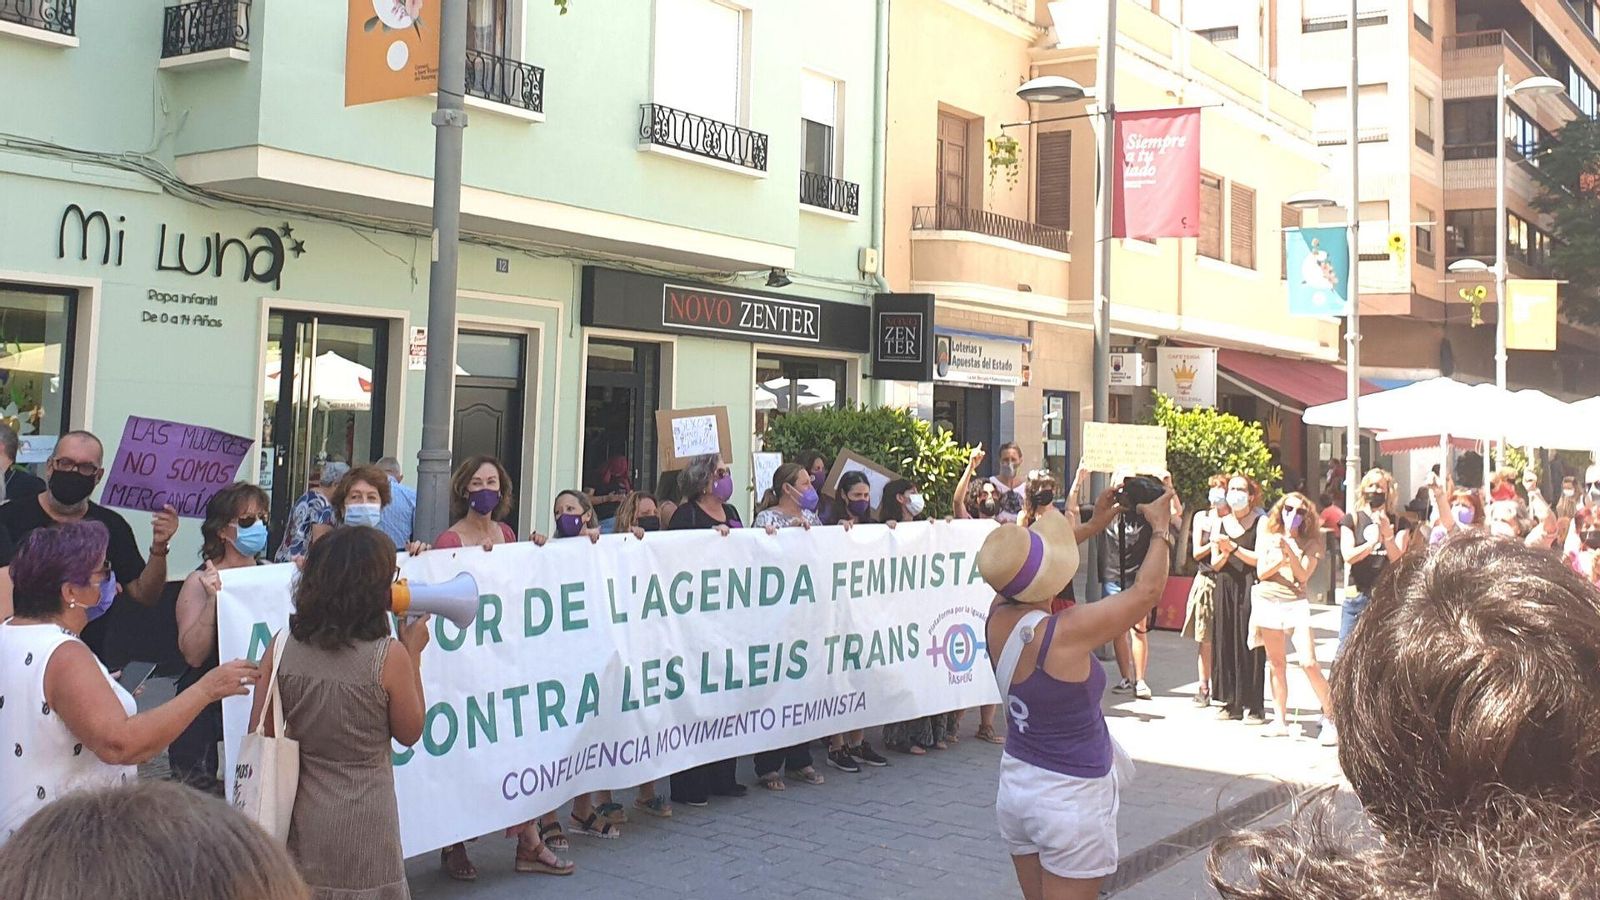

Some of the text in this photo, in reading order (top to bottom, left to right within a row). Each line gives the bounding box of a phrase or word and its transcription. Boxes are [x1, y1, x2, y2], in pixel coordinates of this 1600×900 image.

[1126, 134, 1187, 154] Siempre
[142, 311, 158, 323] De
[170, 315, 178, 324] a
[193, 314, 223, 328] Años
[669, 292, 815, 335] NOVO ZENTER
[884, 340, 916, 355] TER
[885, 326, 917, 341] ZEN
[952, 340, 983, 357] Loterías y
[952, 355, 1013, 372] Apuestas del Estado
[131, 419, 248, 456] LAS MUJERES
[122, 451, 157, 476] NO
[166, 458, 235, 483] SOMOS
[107, 484, 223, 515] MERCANCÍA
[524, 581, 589, 637] DE
[607, 563, 816, 624] L'AGENDA
[831, 551, 987, 602] FEMINISTA
[621, 654, 685, 712] LES
[700, 639, 809, 695] LLEIS
[824, 622, 920, 675] TRANS
[502, 691, 867, 800] CONFLUENCIA MOVIMIENTO FEMINISTA
